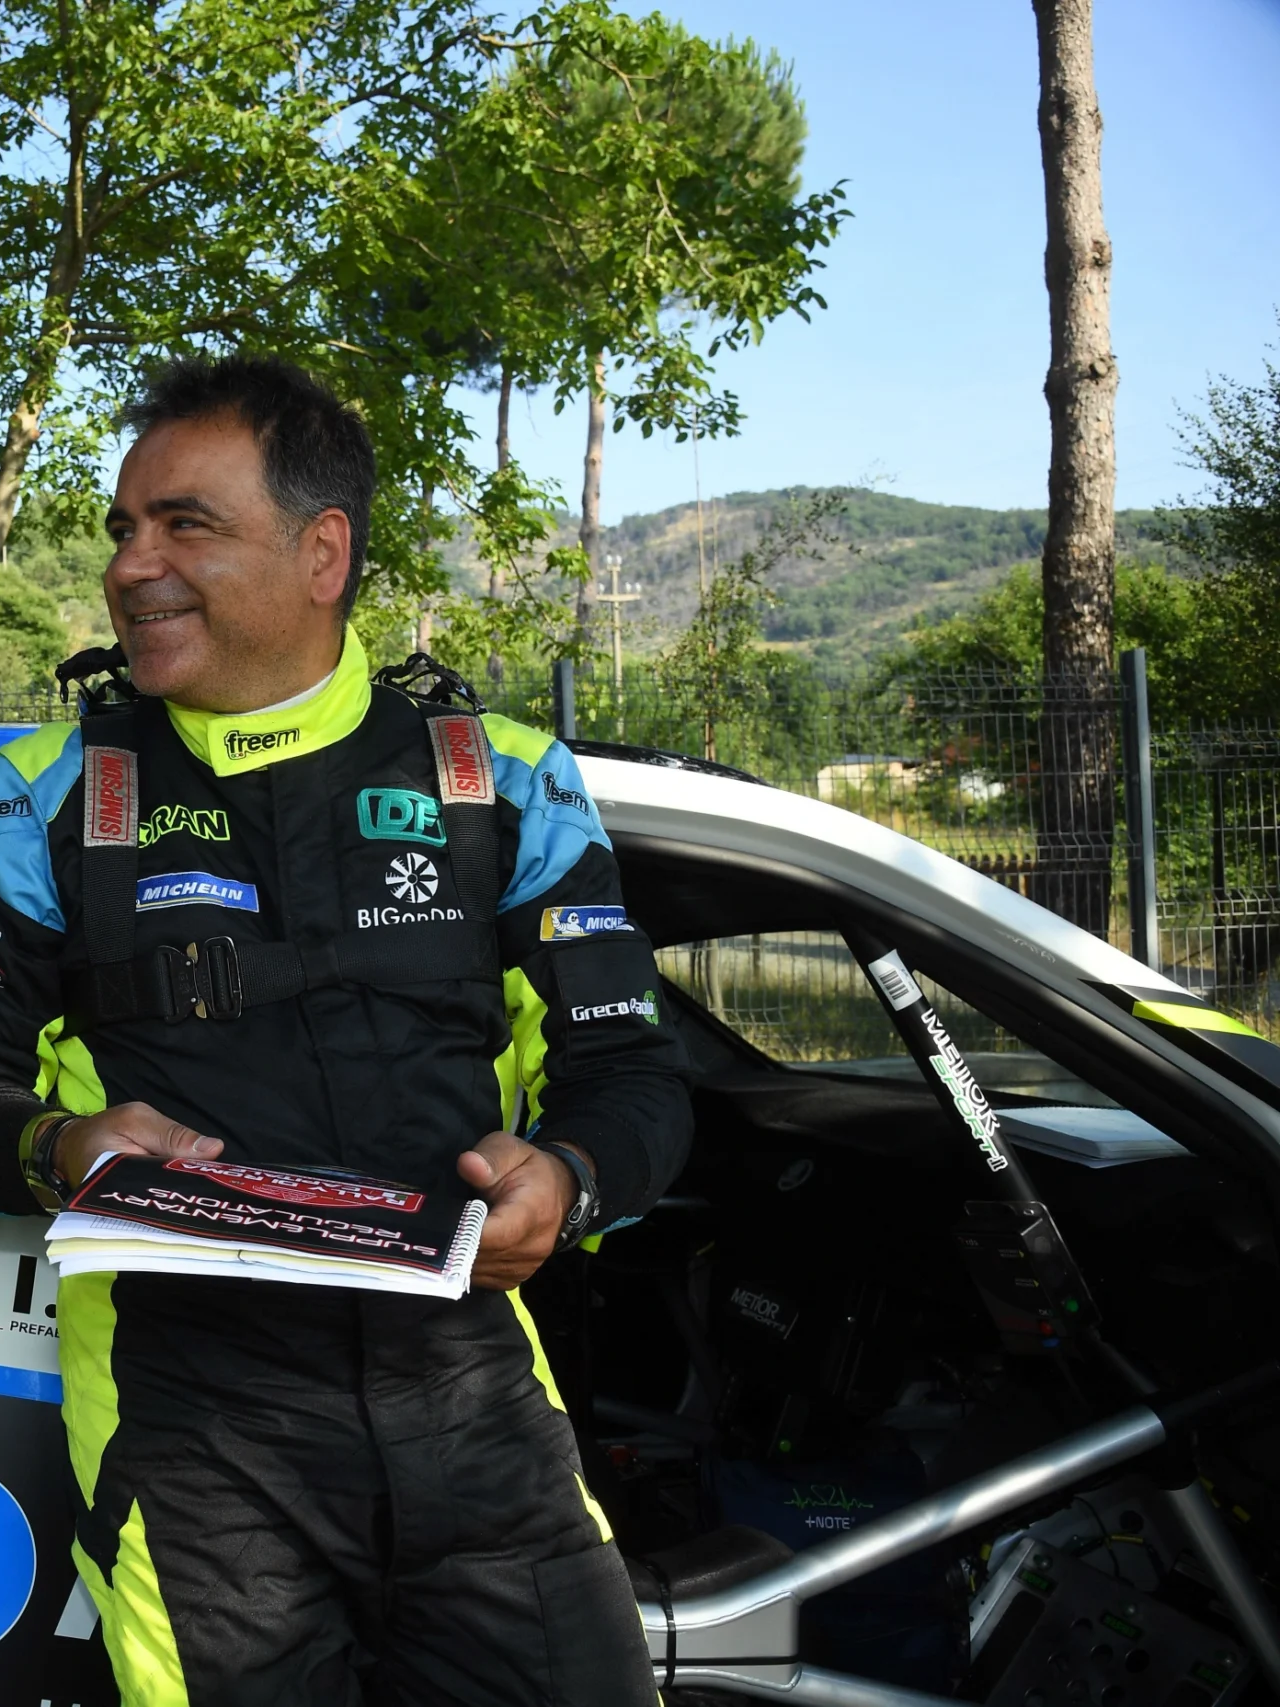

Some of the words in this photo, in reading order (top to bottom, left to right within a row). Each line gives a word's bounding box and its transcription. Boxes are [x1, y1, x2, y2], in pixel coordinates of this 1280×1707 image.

[225, 728, 299, 758] freem
[444, 722, 481, 793] SIMPSON
[99, 755, 124, 836] SIMPSON
[143, 881, 243, 901] MICHELIN
[571, 1001, 629, 1022] Greco
[181, 1163, 265, 1182] ROMA
[266, 1176, 298, 1188] DI
[310, 1184, 408, 1207] RALLY
[99, 1189, 441, 1258] SUPPLEMENTARY
[147, 1187, 404, 1240] REGULATIONS
[730, 1287, 780, 1320] METIOR
